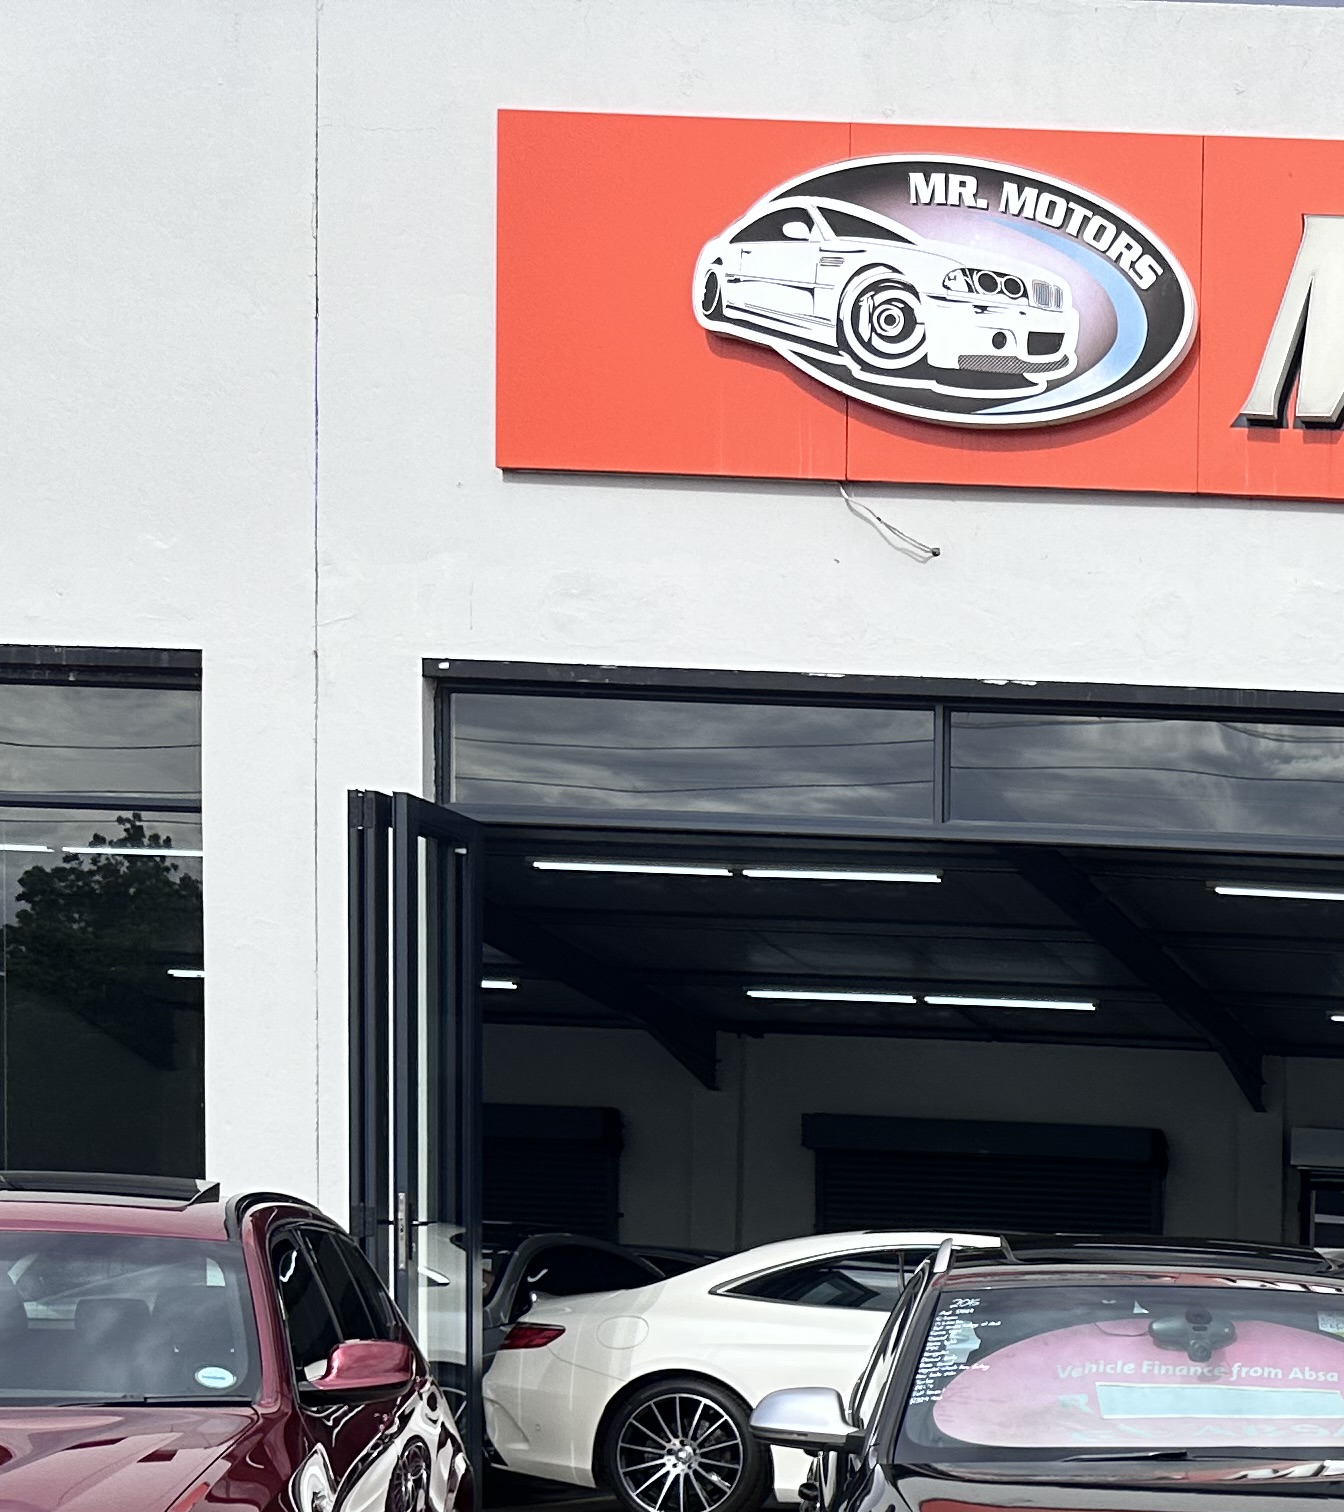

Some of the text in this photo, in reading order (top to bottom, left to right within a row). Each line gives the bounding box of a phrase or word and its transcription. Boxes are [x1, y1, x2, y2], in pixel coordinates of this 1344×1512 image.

[907, 171, 1166, 293] MR. MOTORS
[1056, 1360, 1340, 1383] Vehicle Finance from Absa
